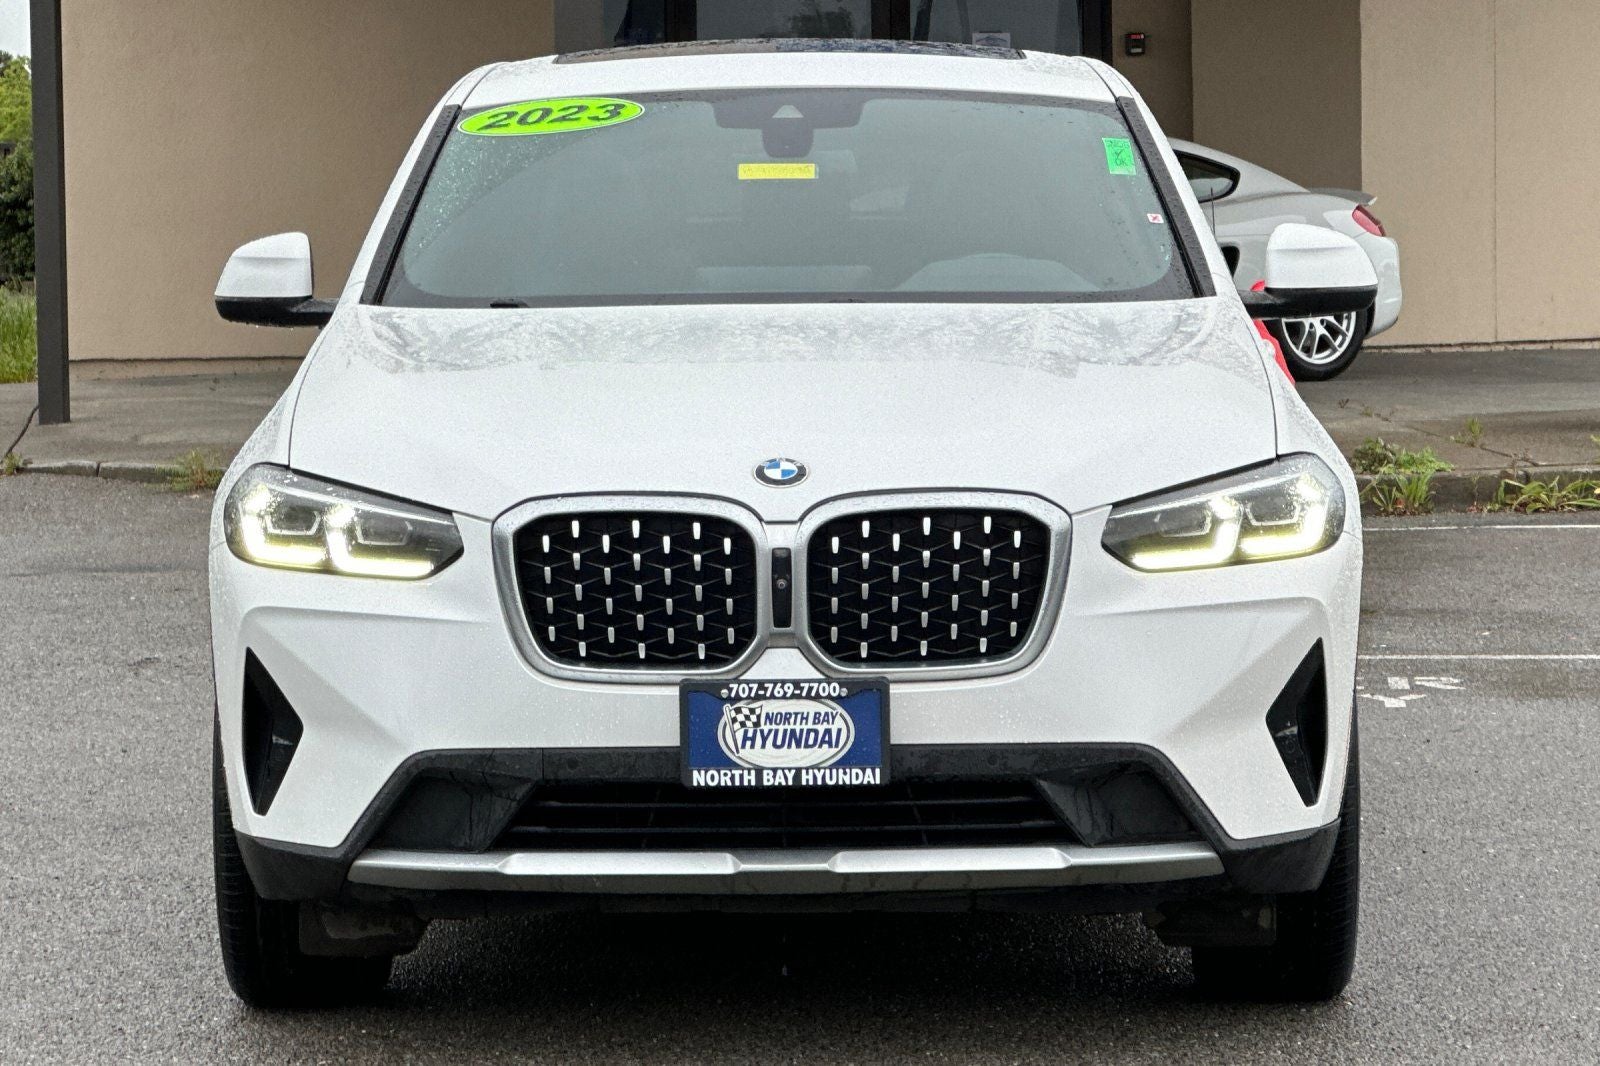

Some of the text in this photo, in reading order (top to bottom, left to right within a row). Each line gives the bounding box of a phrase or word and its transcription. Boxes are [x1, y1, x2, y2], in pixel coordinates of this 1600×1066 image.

[476, 103, 626, 131] 2023
[729, 683, 840, 698] 707-769-7700
[764, 711, 839, 726] NORTH BAY
[741, 727, 843, 749] HYUNDAI
[692, 768, 881, 786] NORTH BAY HYUNDAI
